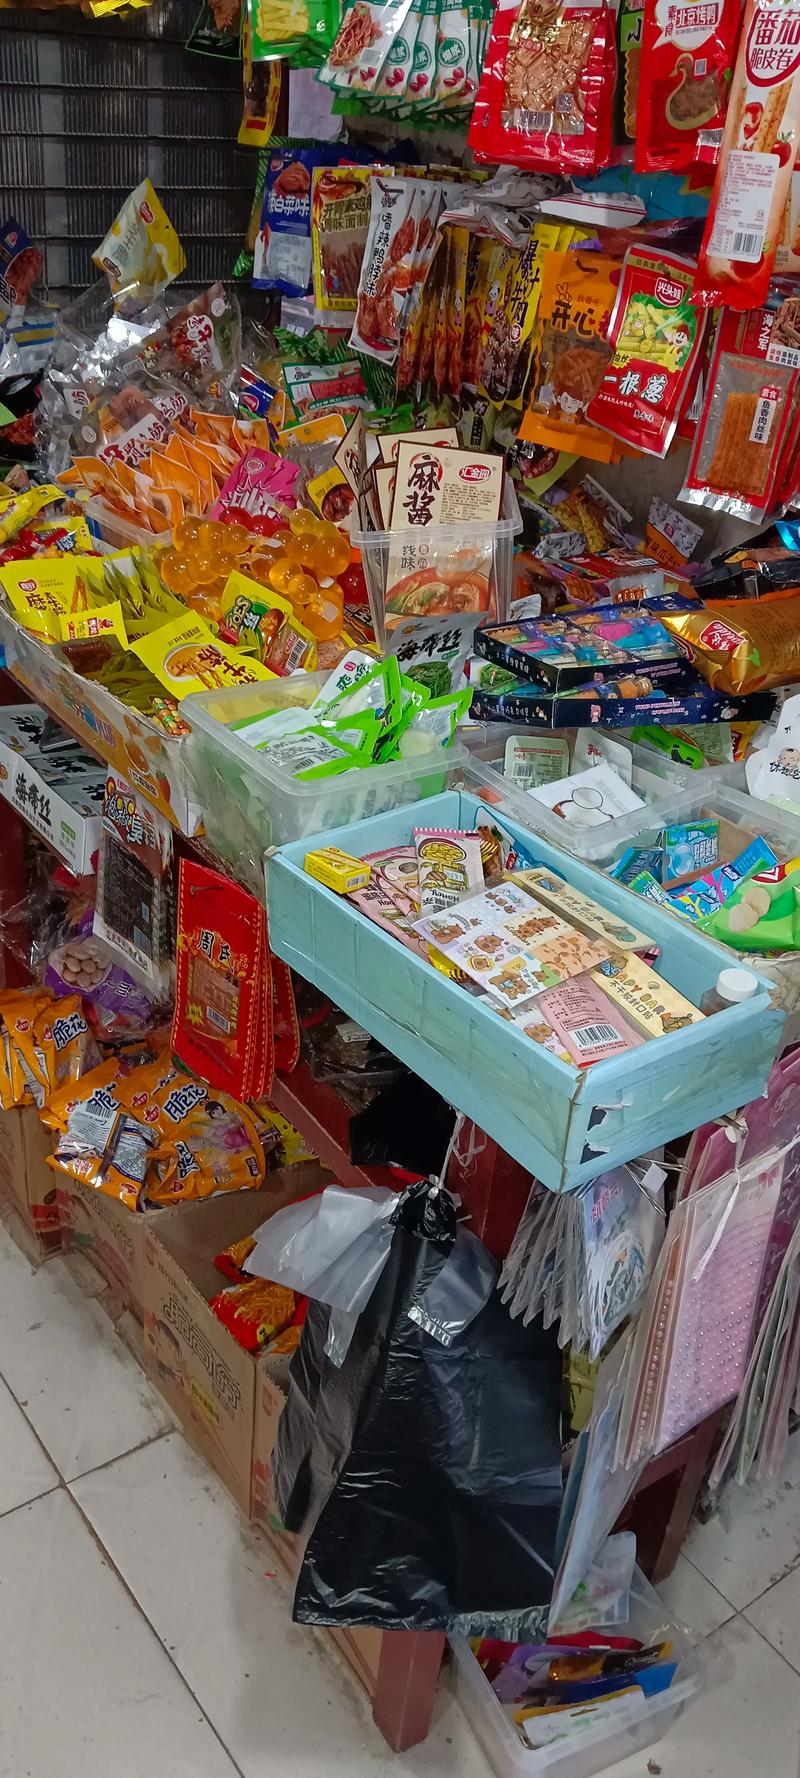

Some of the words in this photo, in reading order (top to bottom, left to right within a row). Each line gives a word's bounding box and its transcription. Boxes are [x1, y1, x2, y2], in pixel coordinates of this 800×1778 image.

[675, 5, 717, 27] 北京烤鸭
[756, 9, 800, 45] 番茄
[750, 47, 793, 70] 脆皮卷
[754, 400, 771, 441] 鱼香肉丝味
[403, 455, 441, 526] 麻酱
[397, 628, 463, 661] 海带丝
[16, 772, 52, 827] 海带丝
[430, 889, 460, 902] Honey
[53, 1013, 88, 1049] 脆花
[164, 1084, 206, 1123] 脆花
